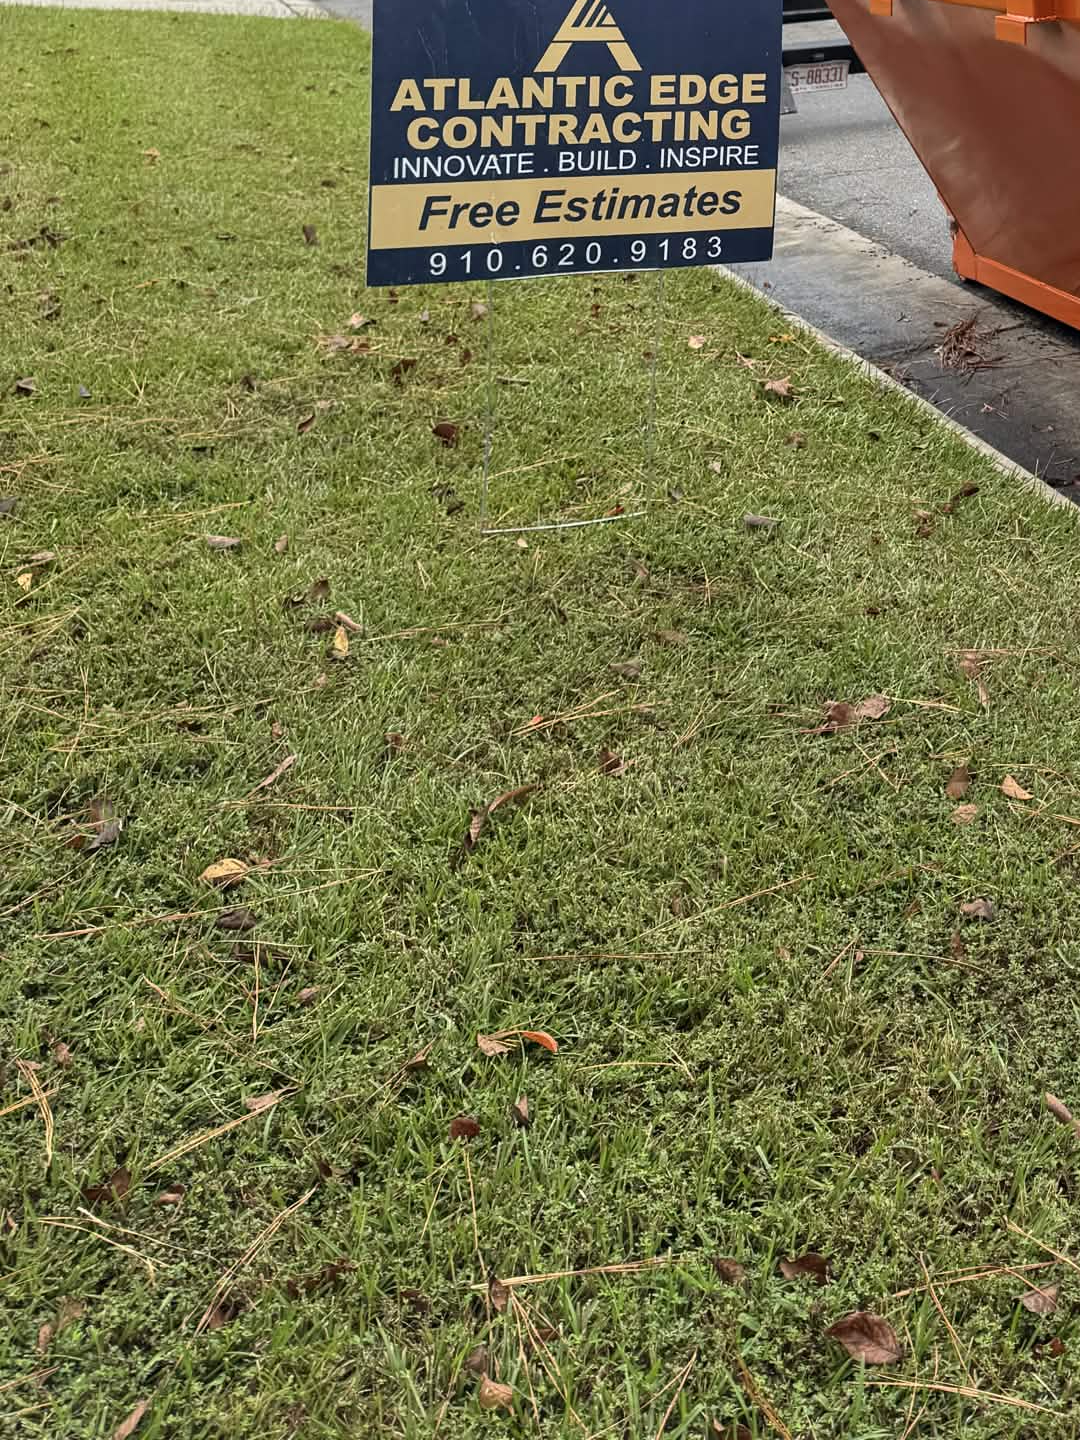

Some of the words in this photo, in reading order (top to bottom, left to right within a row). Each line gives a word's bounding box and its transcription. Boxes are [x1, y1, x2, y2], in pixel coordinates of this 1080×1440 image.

[390, 76, 634, 112] ATLANTIC
[650, 73, 767, 106] EDGE
[406, 109, 751, 150] CONTRACTING
[393, 153, 534, 179] INNOVATE
[558, 149, 637, 172] BUILD
[660, 145, 760, 169] INSPIRE
[418, 195, 520, 231] Free
[532, 185, 743, 224] Estimates
[429, 235, 722, 276] 910.620.9183
